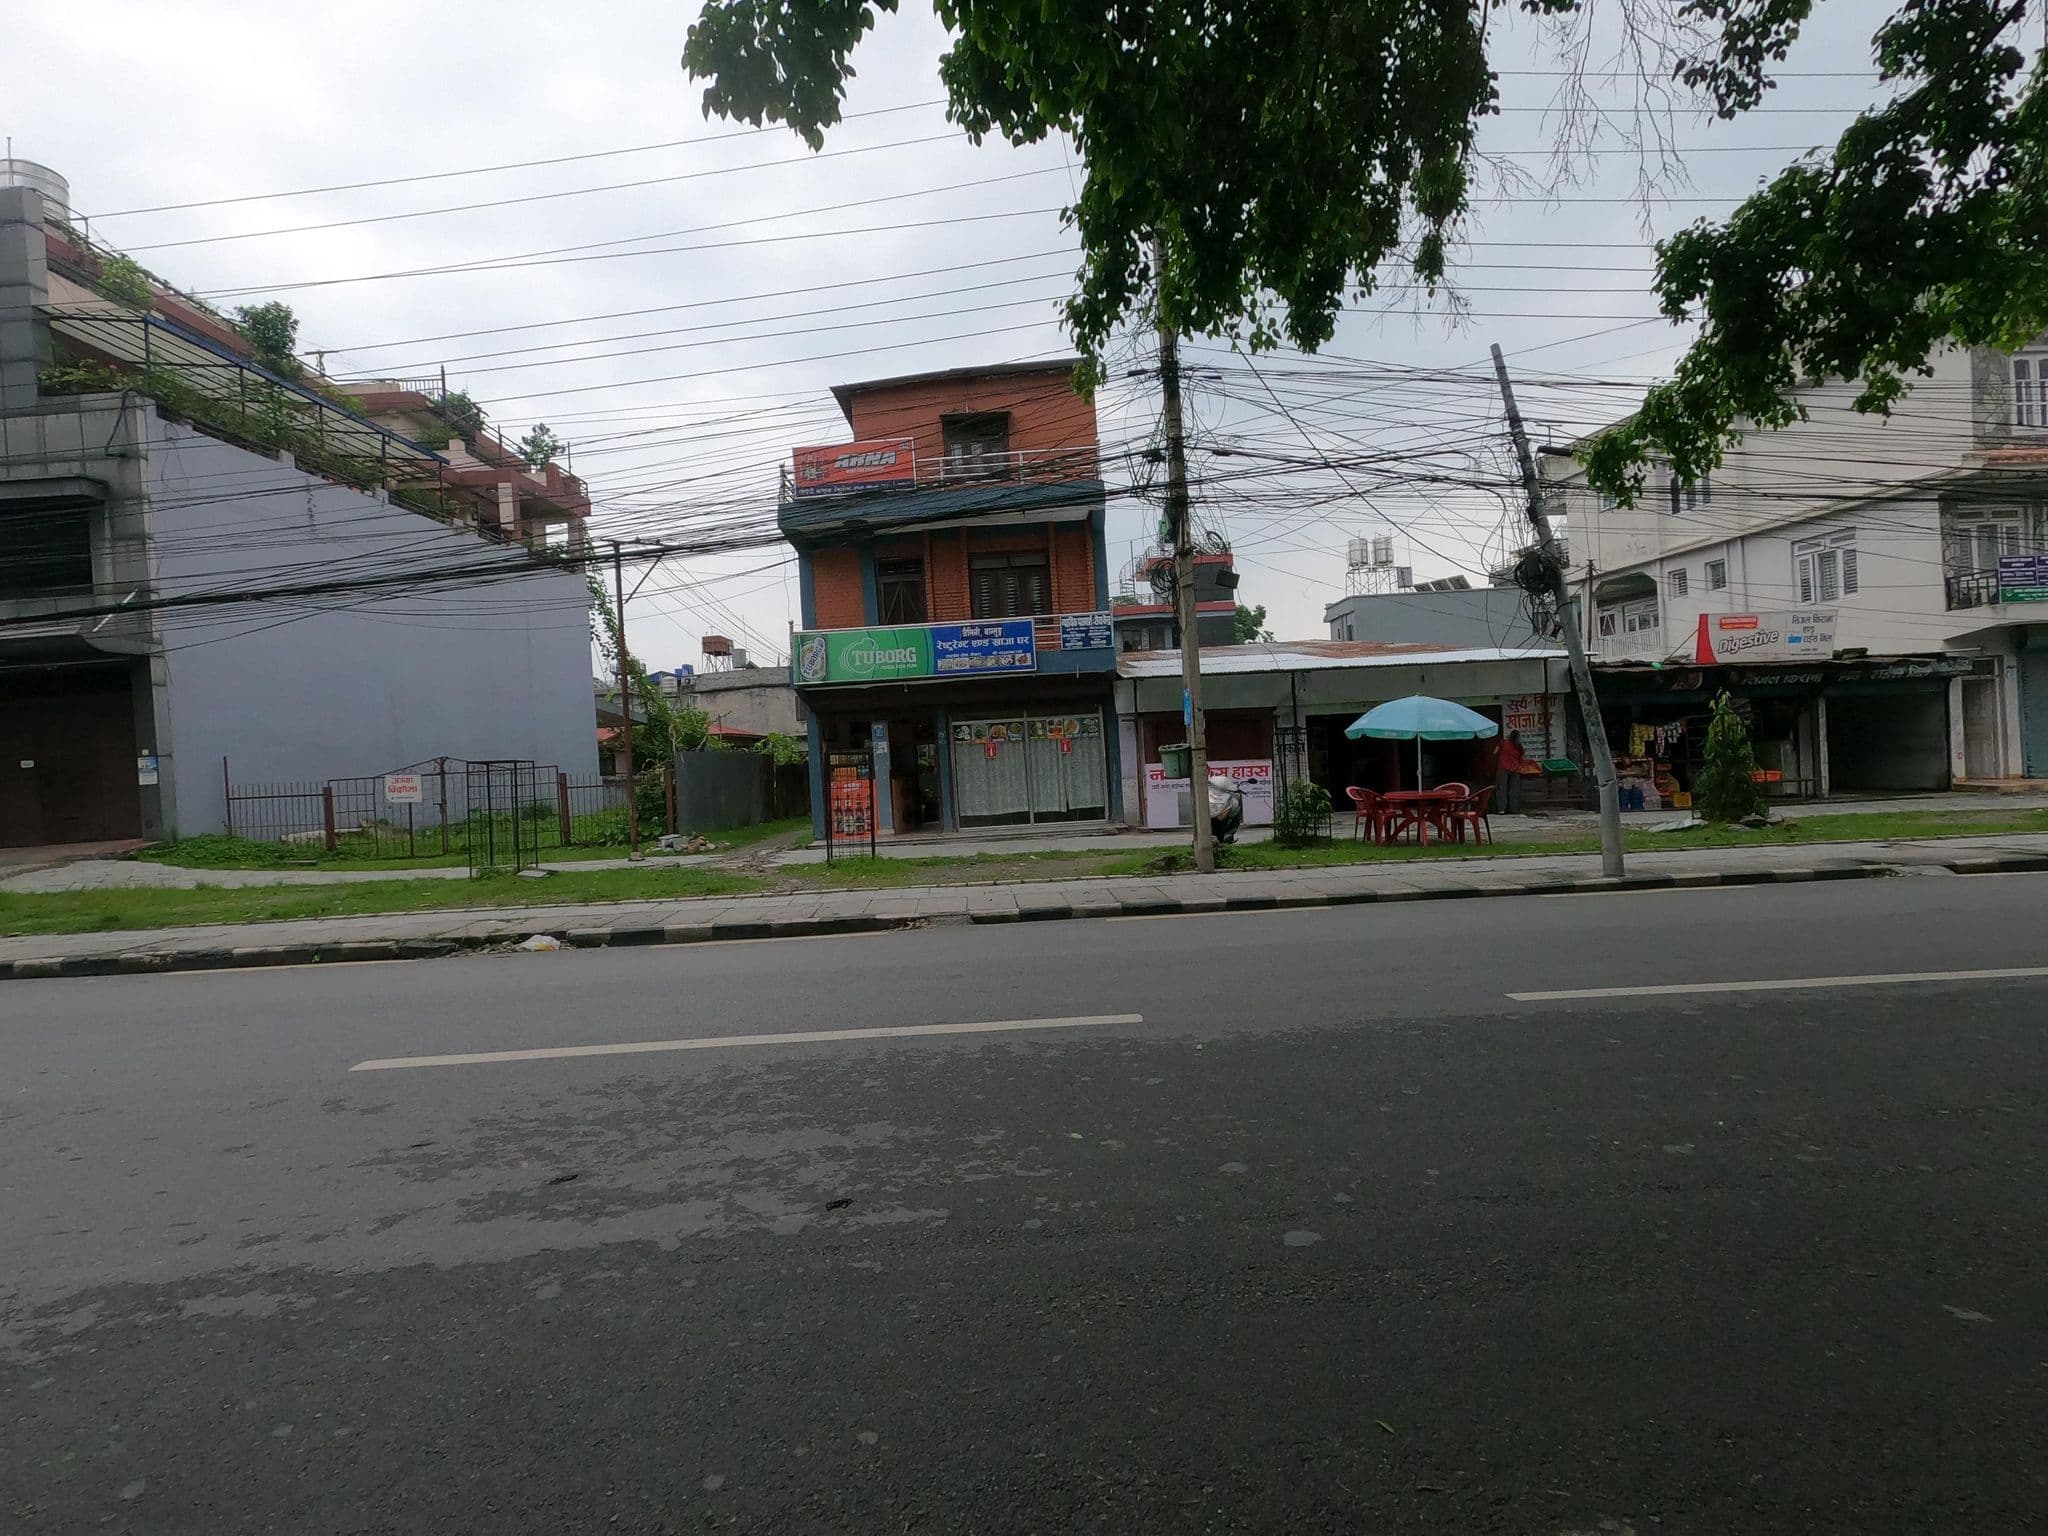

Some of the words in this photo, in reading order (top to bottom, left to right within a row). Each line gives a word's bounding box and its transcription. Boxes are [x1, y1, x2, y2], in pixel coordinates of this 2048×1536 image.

[992, 636, 1014, 647] खाजा
[1016, 636, 1030, 645] घर
[1718, 629, 1779, 655] Digestive
[803, 640, 824, 676] TUBORG
[852, 647, 917, 666] TUBORG
[1505, 713, 1536, 729] खाजा
[1232, 765, 1271, 780] हाउस
